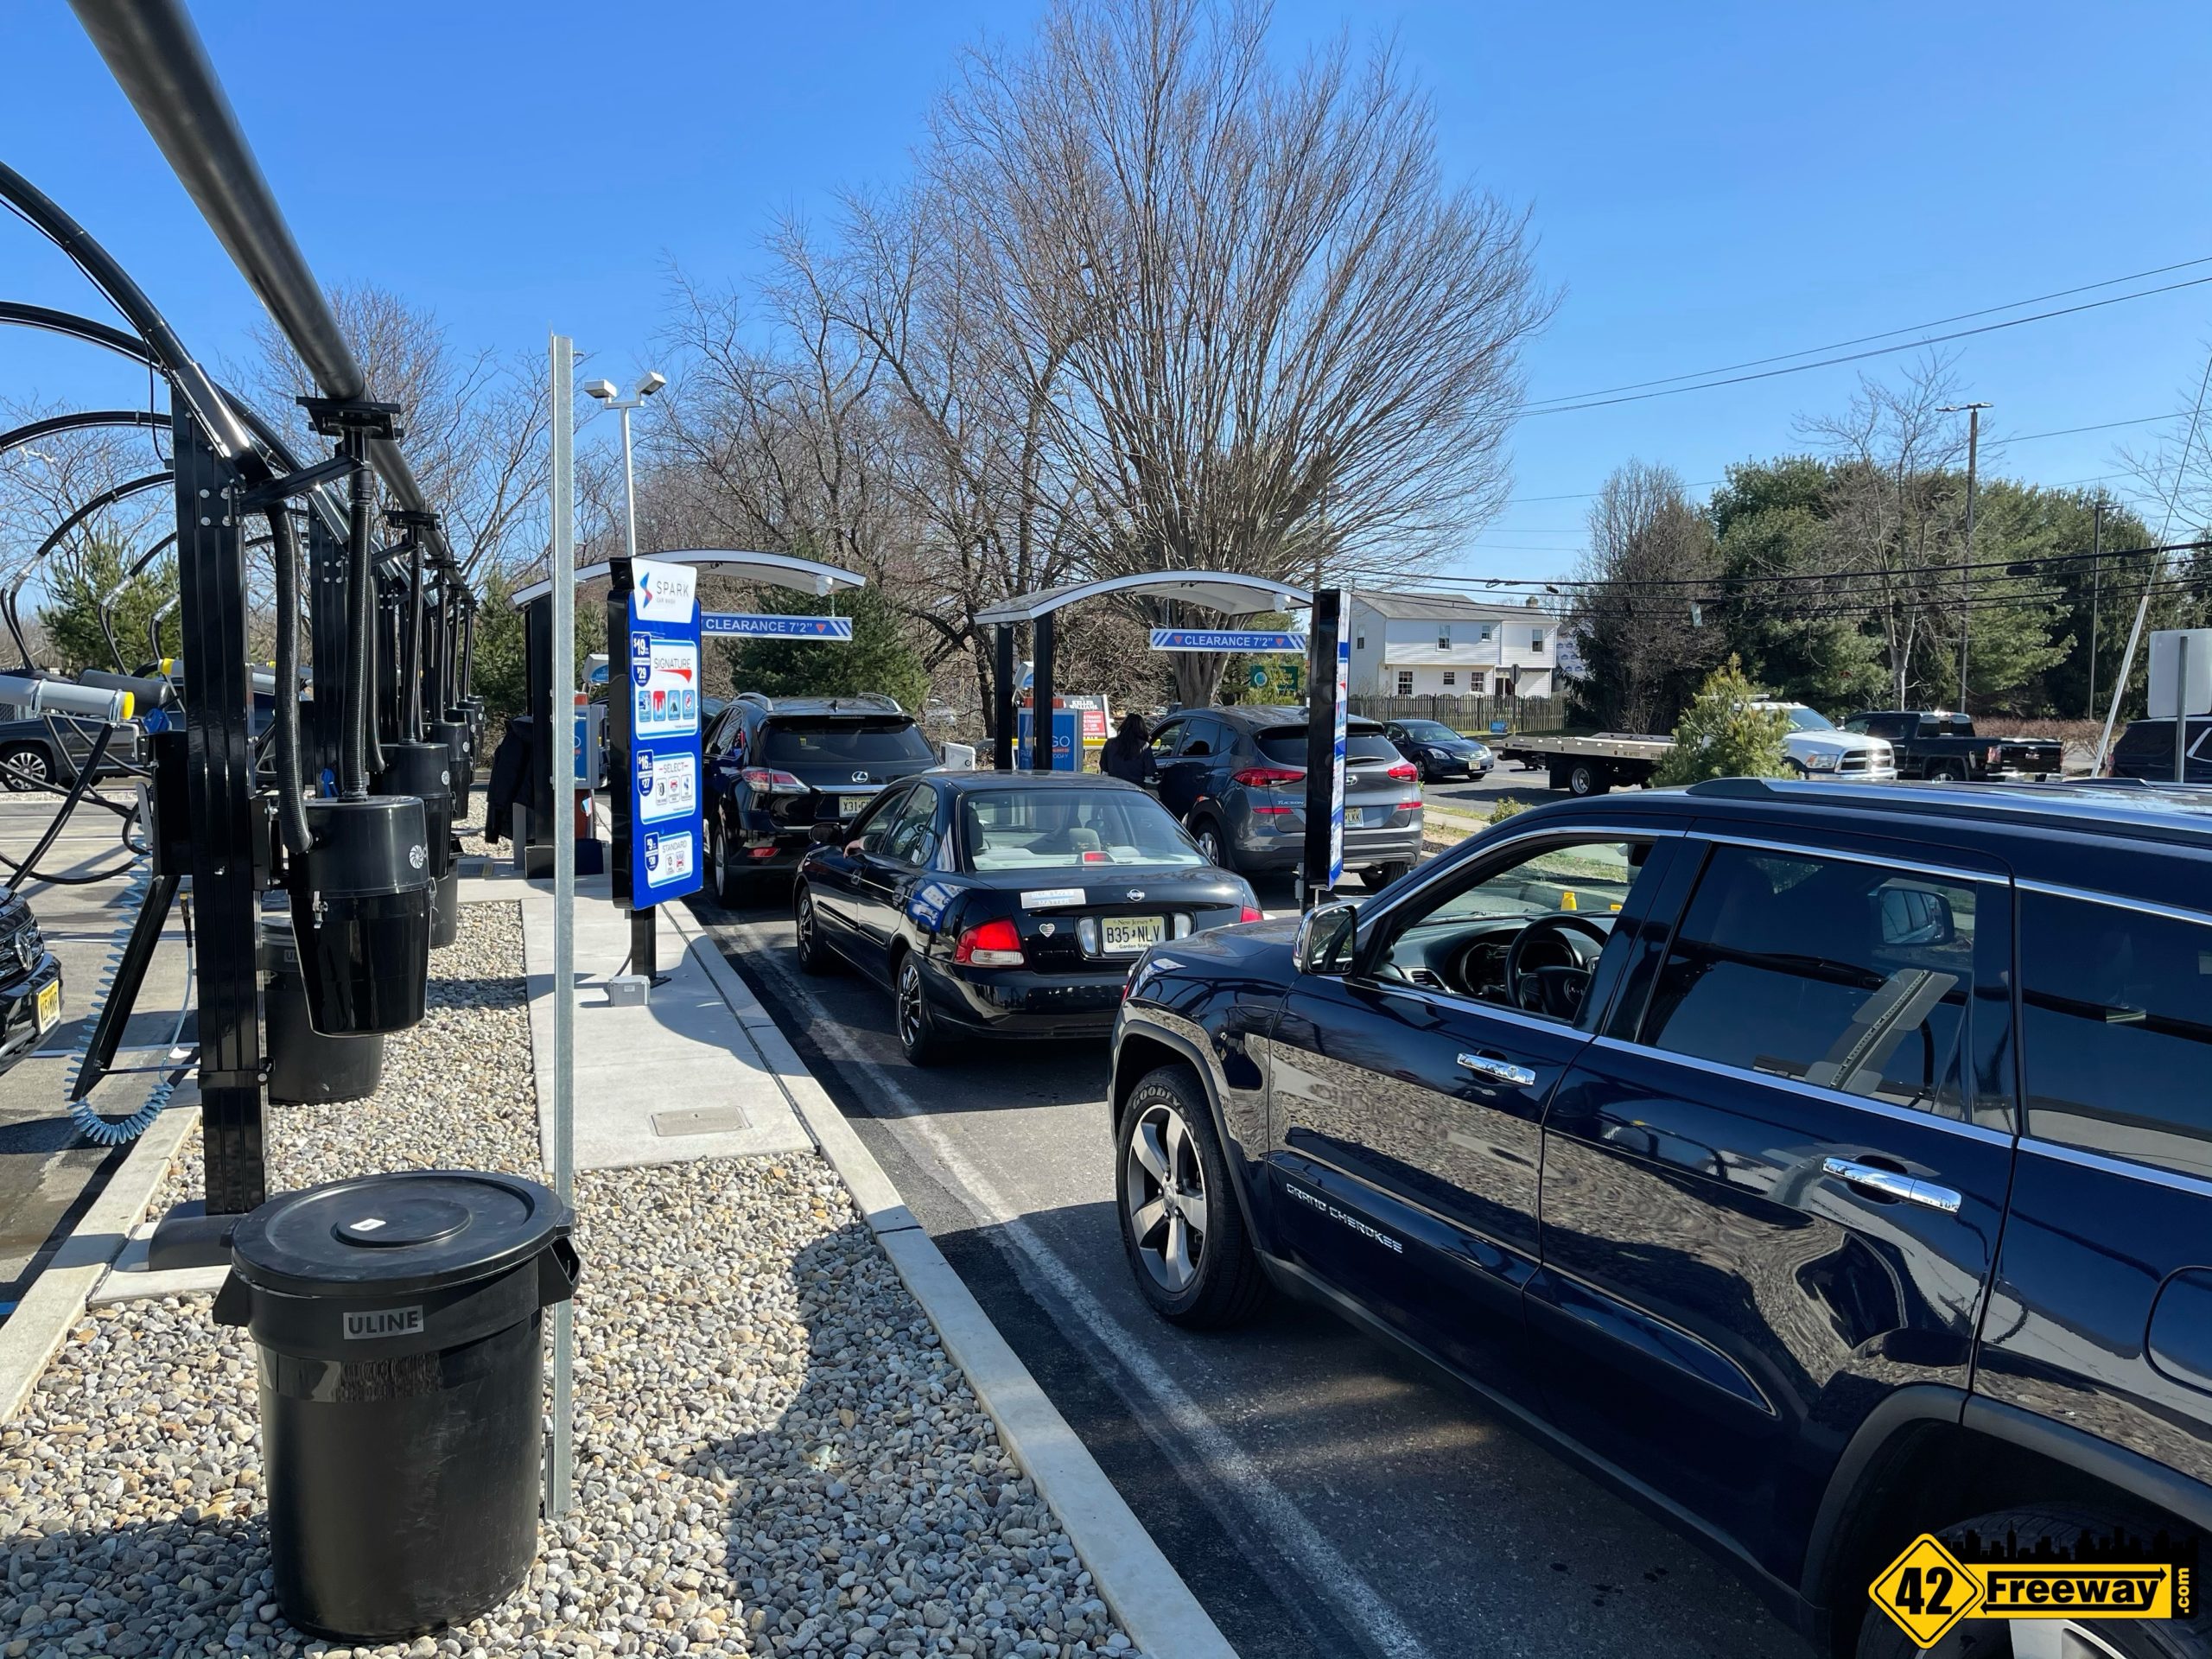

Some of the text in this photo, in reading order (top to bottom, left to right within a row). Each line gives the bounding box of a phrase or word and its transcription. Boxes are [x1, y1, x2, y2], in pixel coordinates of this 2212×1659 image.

[656, 581, 690, 598] SPARK
[705, 619, 786, 632] CLEARANCE
[633, 638, 646, 656] $19
[1184, 635, 1251, 647] CLEARANCE
[653, 658, 692, 670] SIGNATURE
[1052, 735, 1071, 747] GO
[664, 762, 684, 773] SELECT
[662, 840, 688, 854] STANDARD
[1286, 1182, 1403, 1254] GRAND CHEROKEE
[348, 1310, 418, 1335] ULINE
